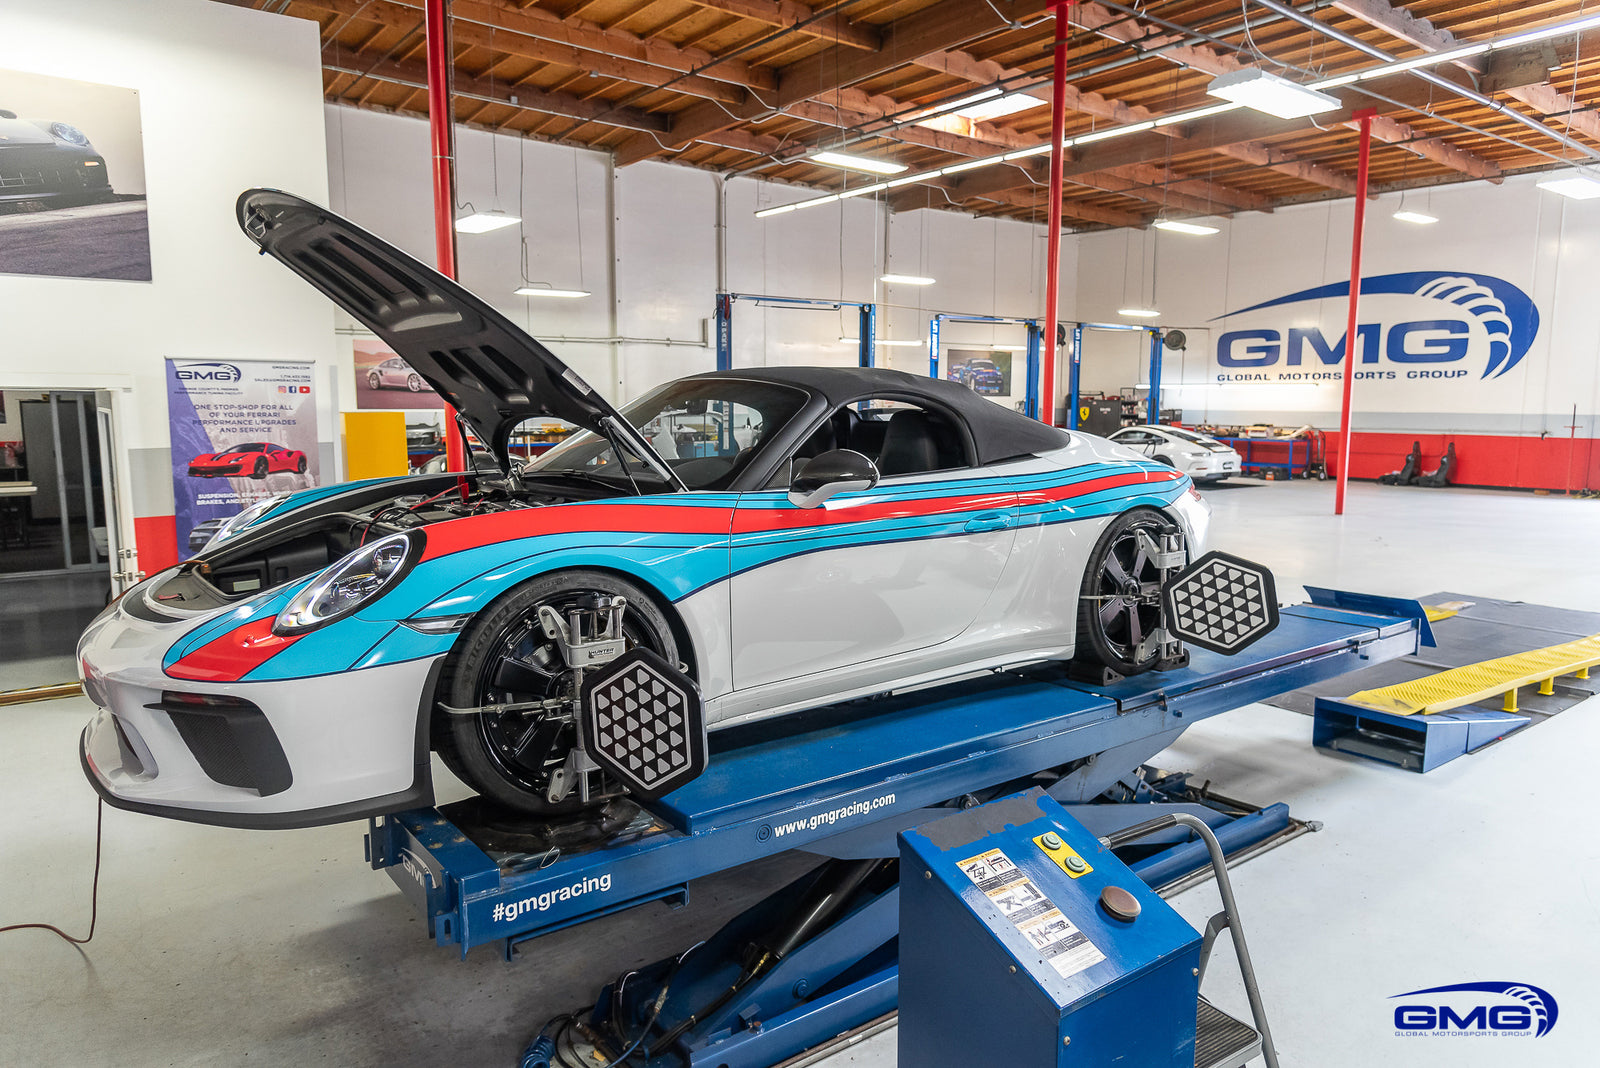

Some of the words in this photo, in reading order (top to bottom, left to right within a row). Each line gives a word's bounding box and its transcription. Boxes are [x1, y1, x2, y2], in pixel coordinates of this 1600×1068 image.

[1216, 319, 1470, 368] GMG
[175, 370, 231, 381] GMG
[1217, 373, 1271, 382] GLOBAL
[1279, 371, 1396, 381] MOTORSORTS
[1406, 369, 1468, 379] GROUP
[774, 792, 896, 838] www.gmgracing.com
[492, 872, 612, 923] #gmgracing
